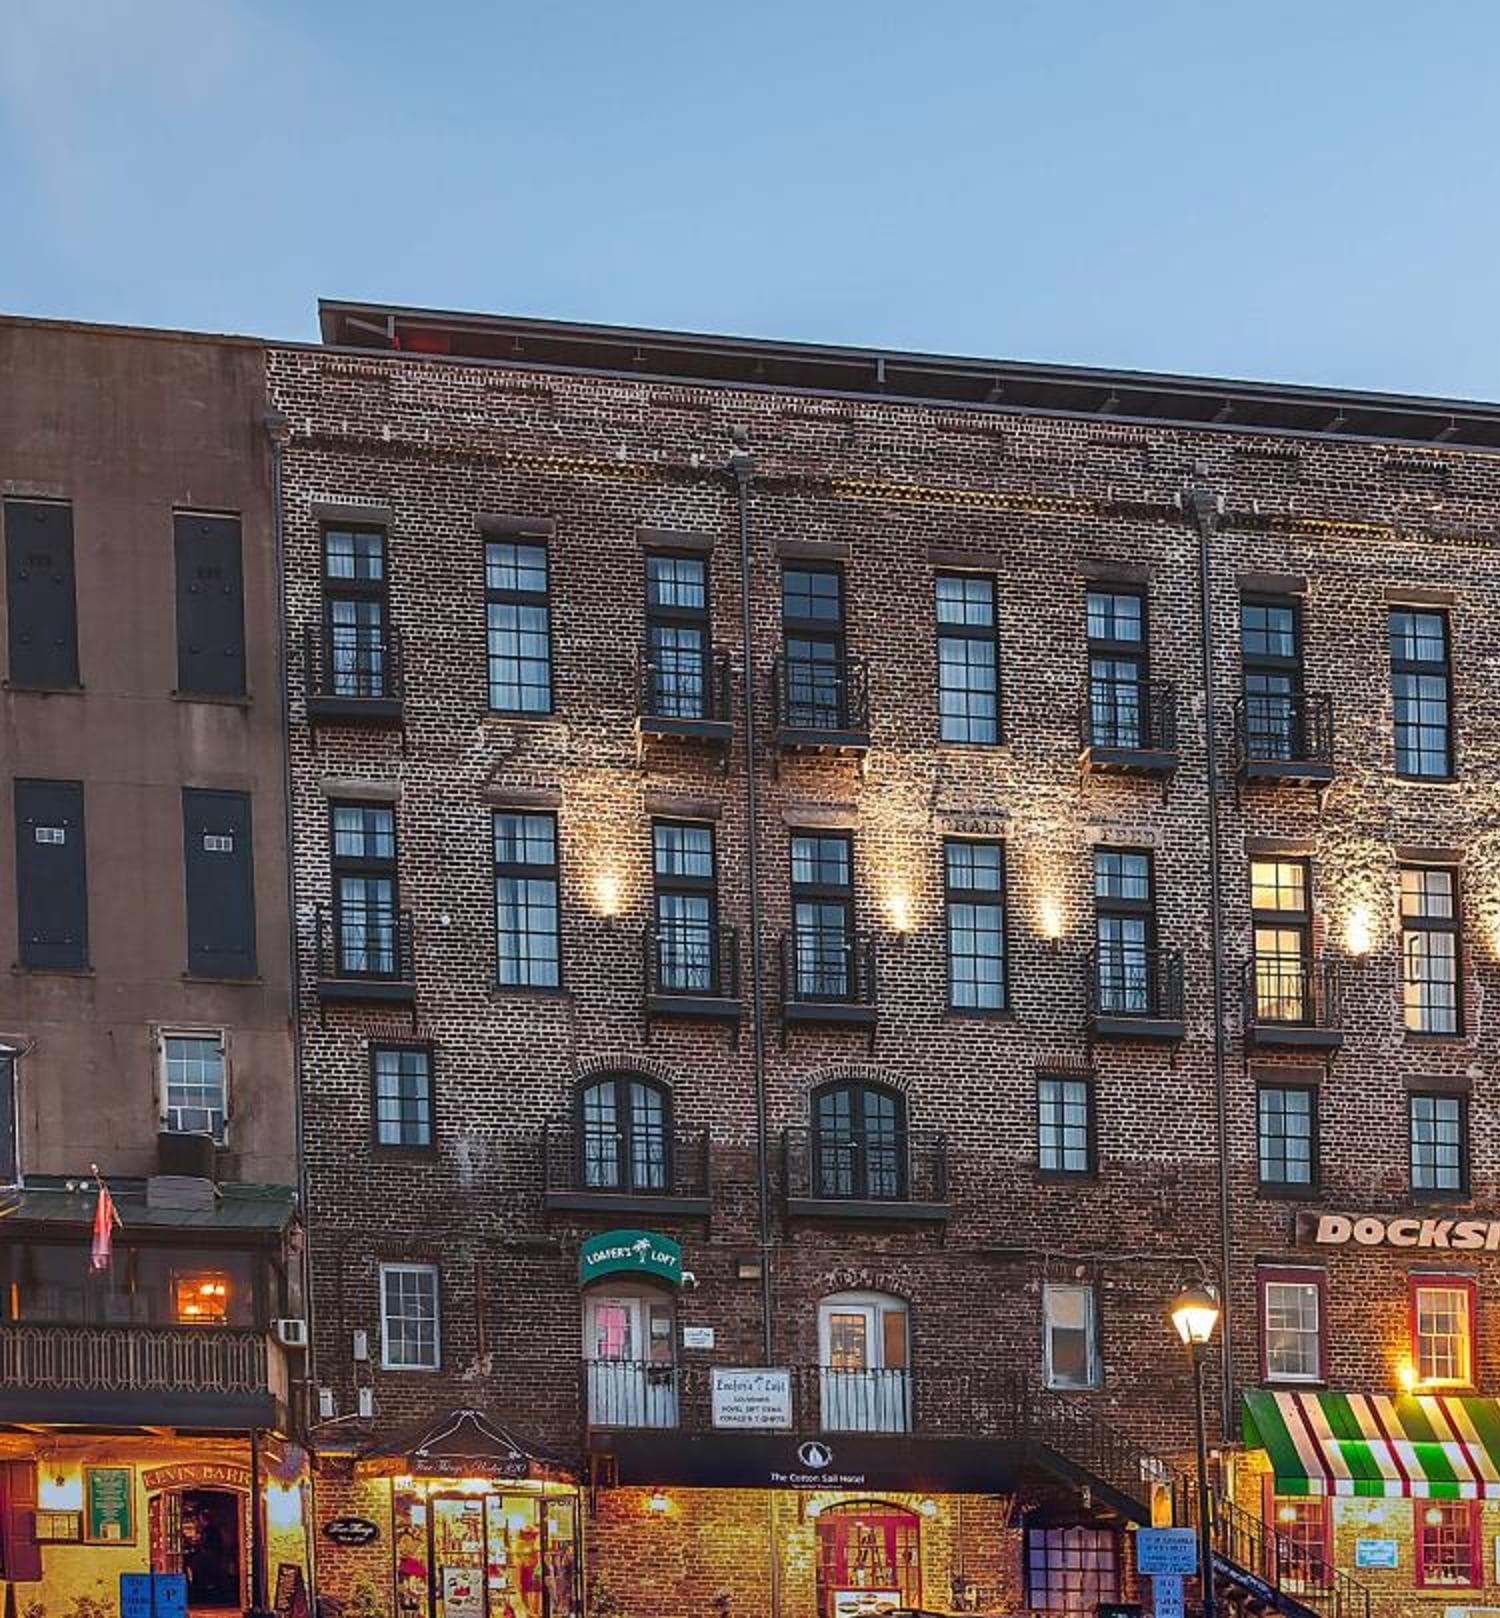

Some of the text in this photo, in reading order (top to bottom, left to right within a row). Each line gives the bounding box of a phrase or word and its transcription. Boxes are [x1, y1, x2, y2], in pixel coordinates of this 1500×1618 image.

[586, 1247, 677, 1267] LOAFER'S LOFT
[144, 1466, 252, 1487] KEVIN BARR
[770, 1472, 865, 1484] The Cotton Sail Hotel
